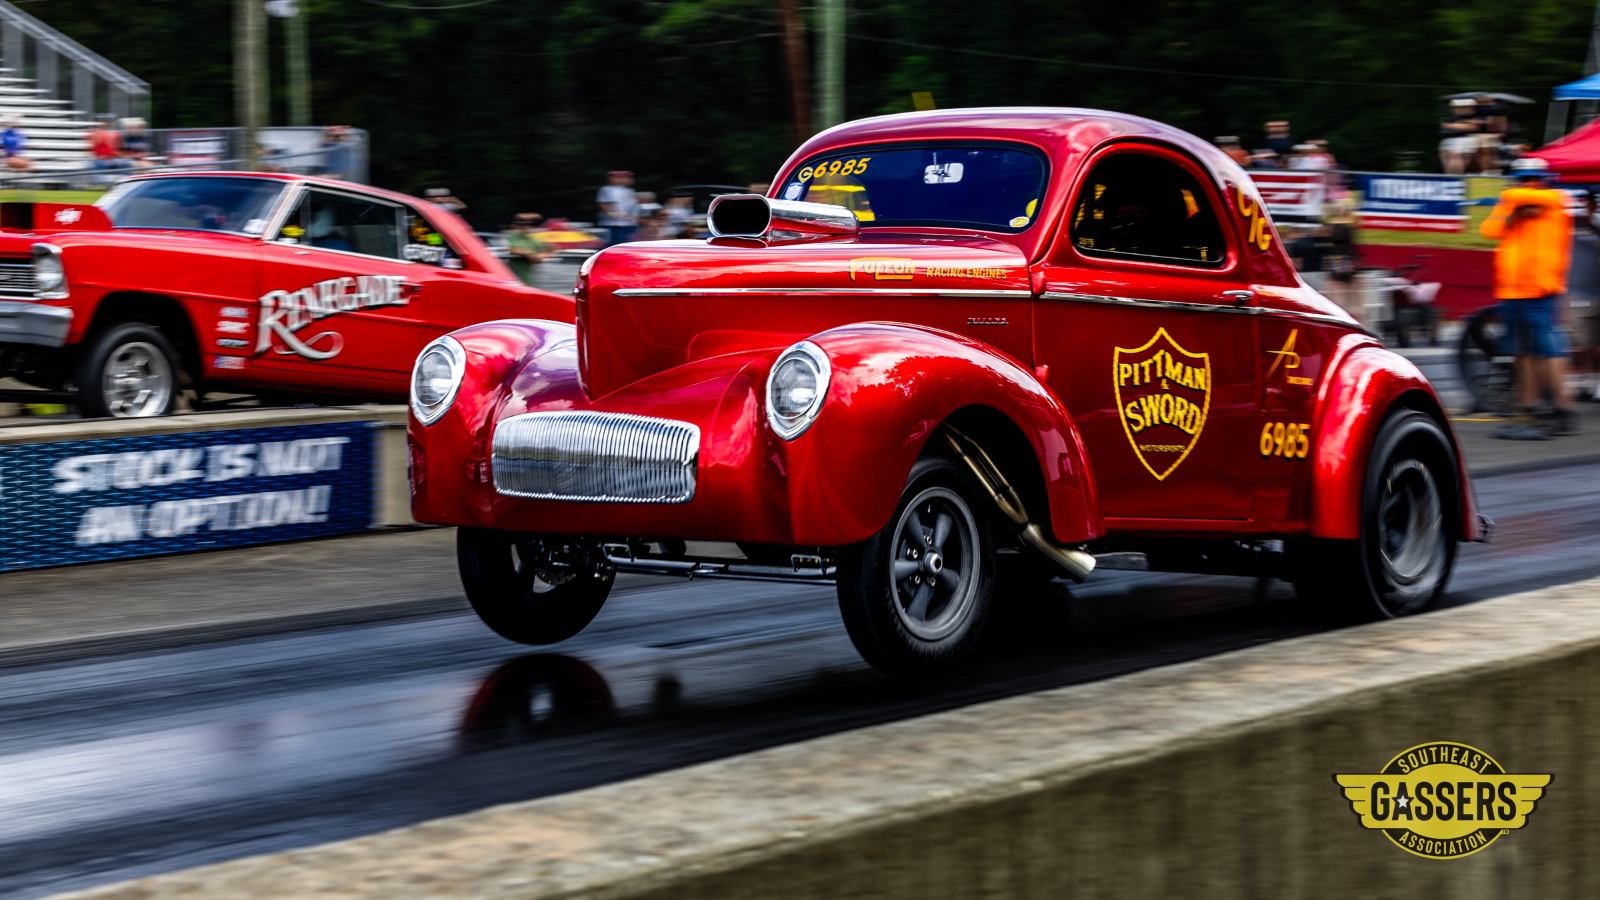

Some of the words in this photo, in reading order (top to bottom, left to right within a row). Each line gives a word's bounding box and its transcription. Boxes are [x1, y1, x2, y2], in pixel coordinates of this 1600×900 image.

[848, 257, 916, 281] FULTON
[926, 267, 964, 279] RACING
[966, 268, 1008, 280] ENGINES
[254, 275, 410, 359] RENEGADE
[1119, 349, 1207, 391] PITTMAN
[1160, 378, 1170, 390] &
[1125, 393, 1202, 435] SWORD
[1260, 422, 1311, 459] 6985
[52, 447, 204, 494] STOCK
[205, 443, 259, 482] IS
[255, 437, 351, 477] NOT
[75, 504, 147, 545] AN
